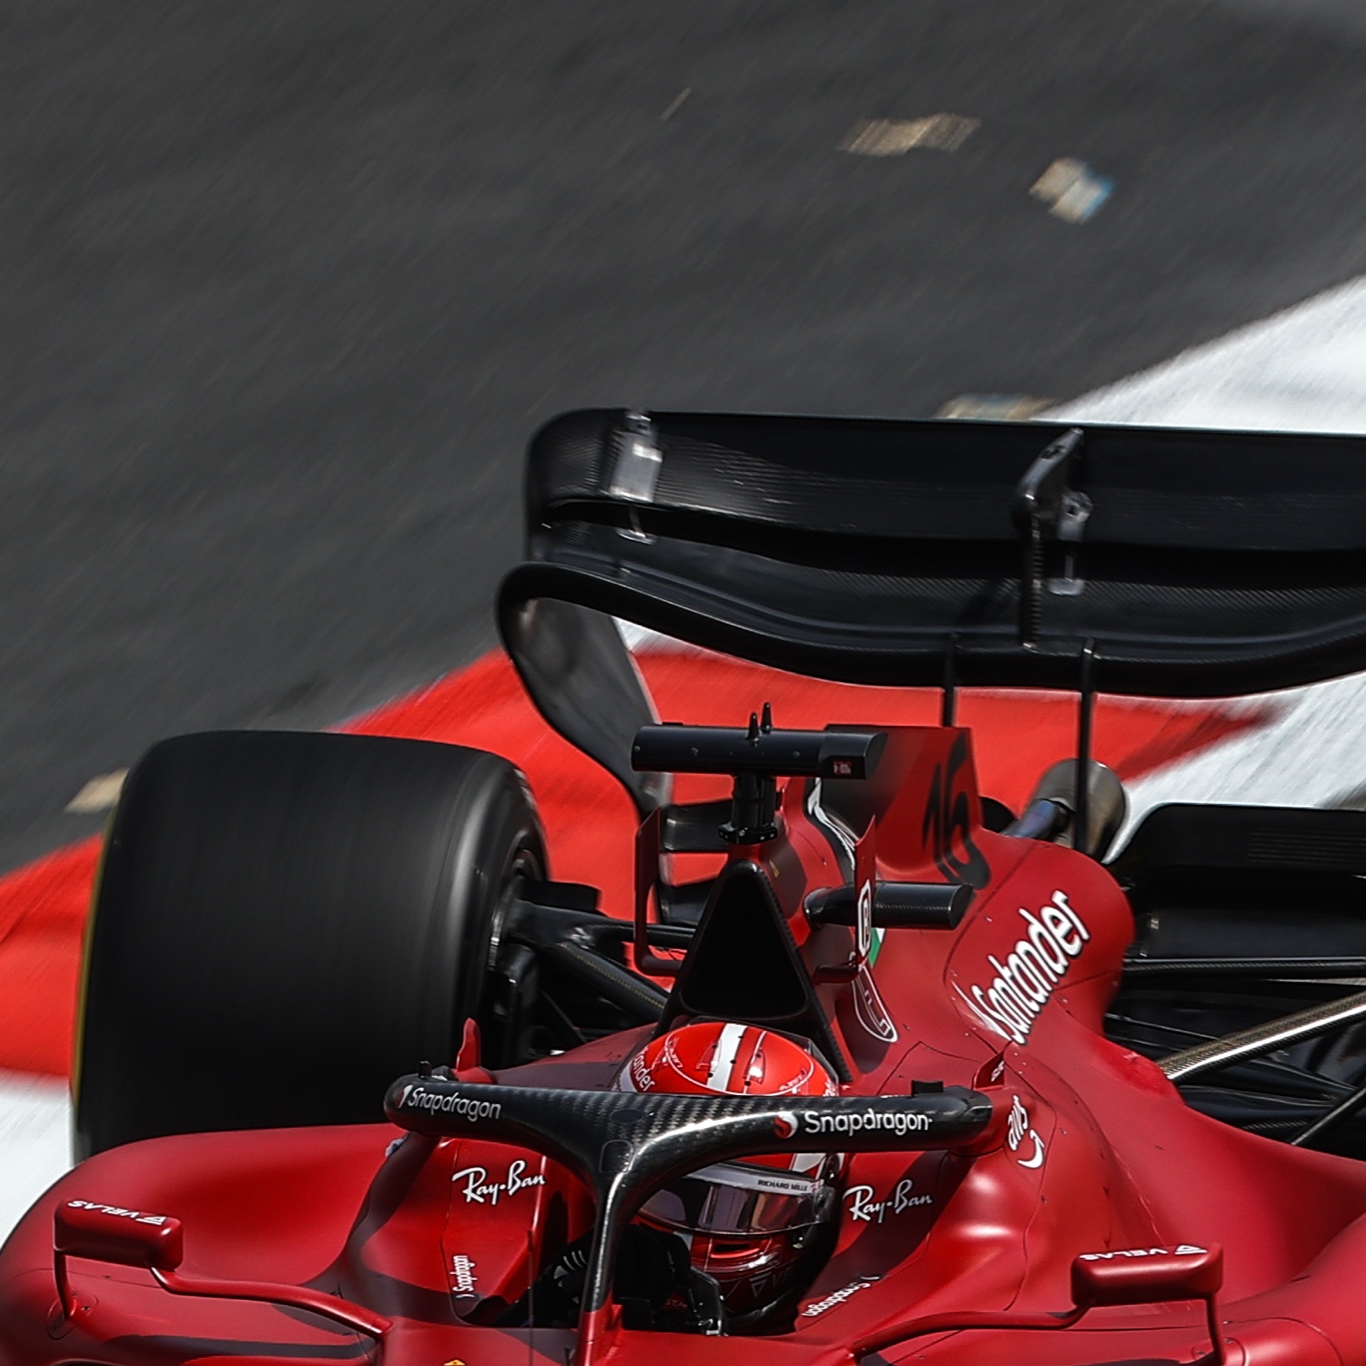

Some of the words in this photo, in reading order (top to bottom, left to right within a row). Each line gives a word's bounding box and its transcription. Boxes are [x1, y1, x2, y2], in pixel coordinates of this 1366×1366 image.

[971, 889, 1090, 1044] Santander
[408, 1087, 501, 1122] Snapdragon
[805, 1108, 930, 1137] Snapdragon
[451, 1160, 545, 1205] Ray-Ban
[842, 1180, 932, 1222] Ray-Ban
